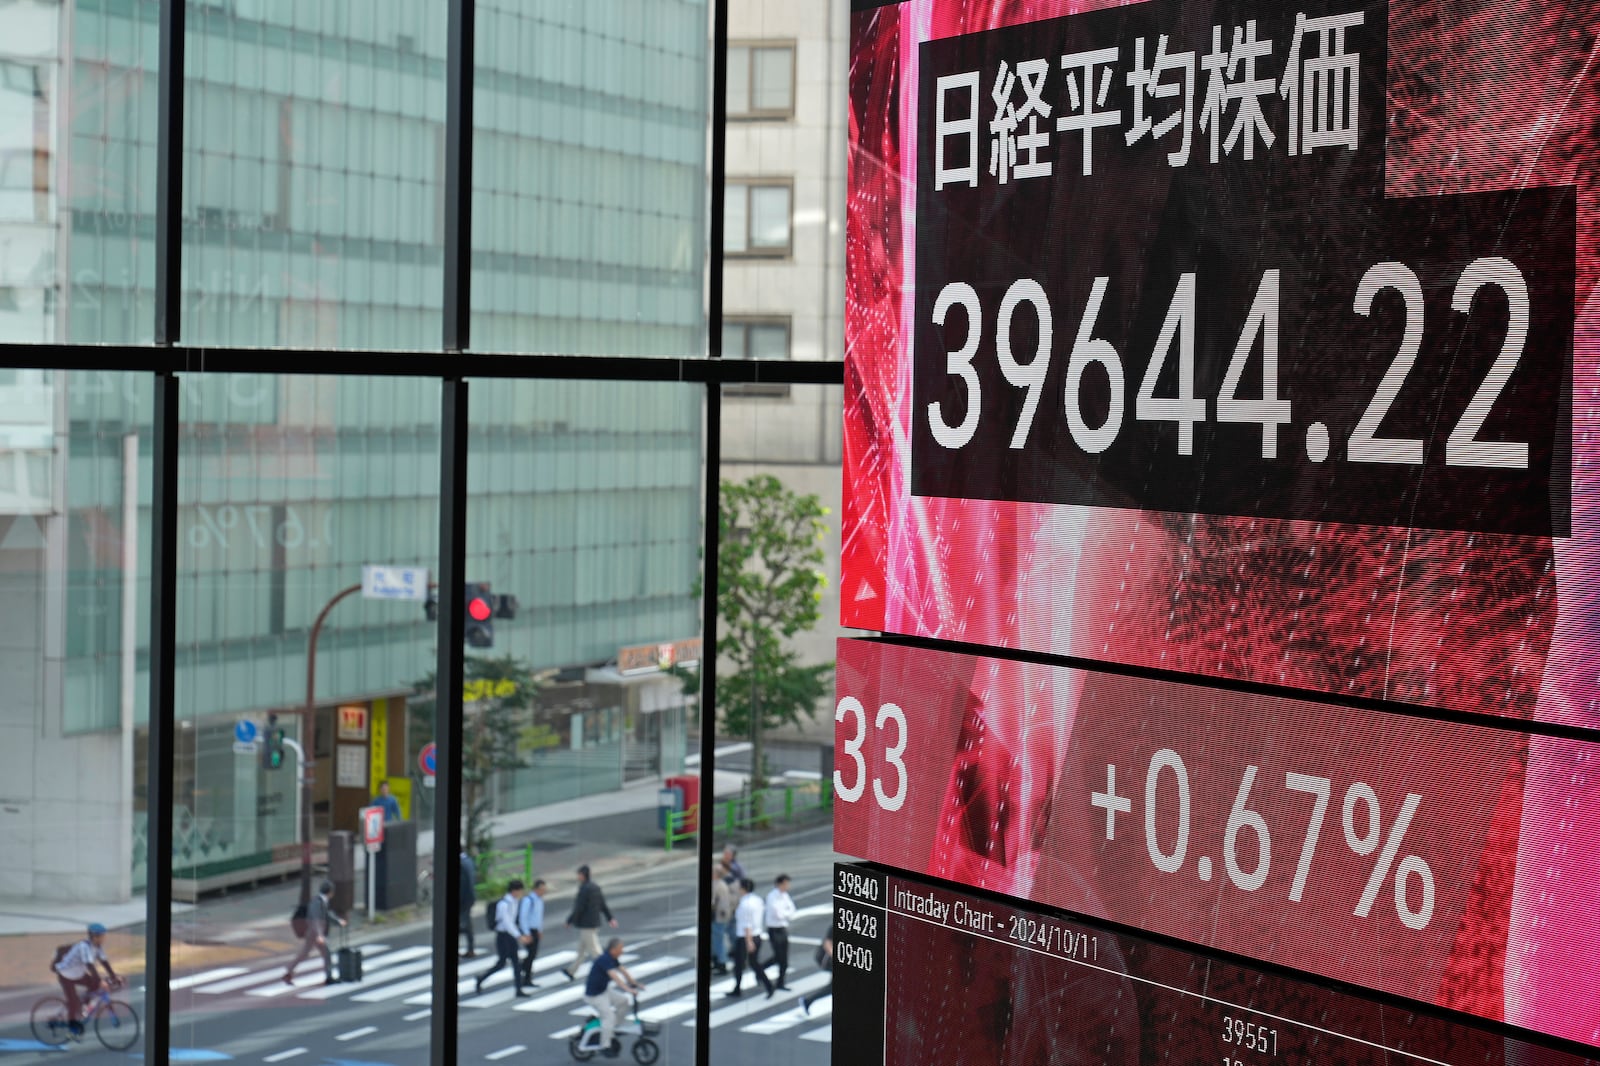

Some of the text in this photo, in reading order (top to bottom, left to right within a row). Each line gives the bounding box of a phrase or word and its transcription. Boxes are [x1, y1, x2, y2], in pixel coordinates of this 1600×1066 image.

[934, 12, 1366, 192] 日経平均株価
[927, 256, 1530, 469] 39644.22
[833, 696, 908, 812] 33
[1091, 748, 1436, 930] +0.67%
[837, 907, 878, 938] 39428
[838, 870, 879, 901] 39840
[893, 885, 951, 926] Intraday
[953, 900, 995, 934] Chart
[1008, 915, 1098, 961] 2024/10/11
[836, 941, 873, 972] 09:00
[1222, 1016, 1277, 1057] 39551
